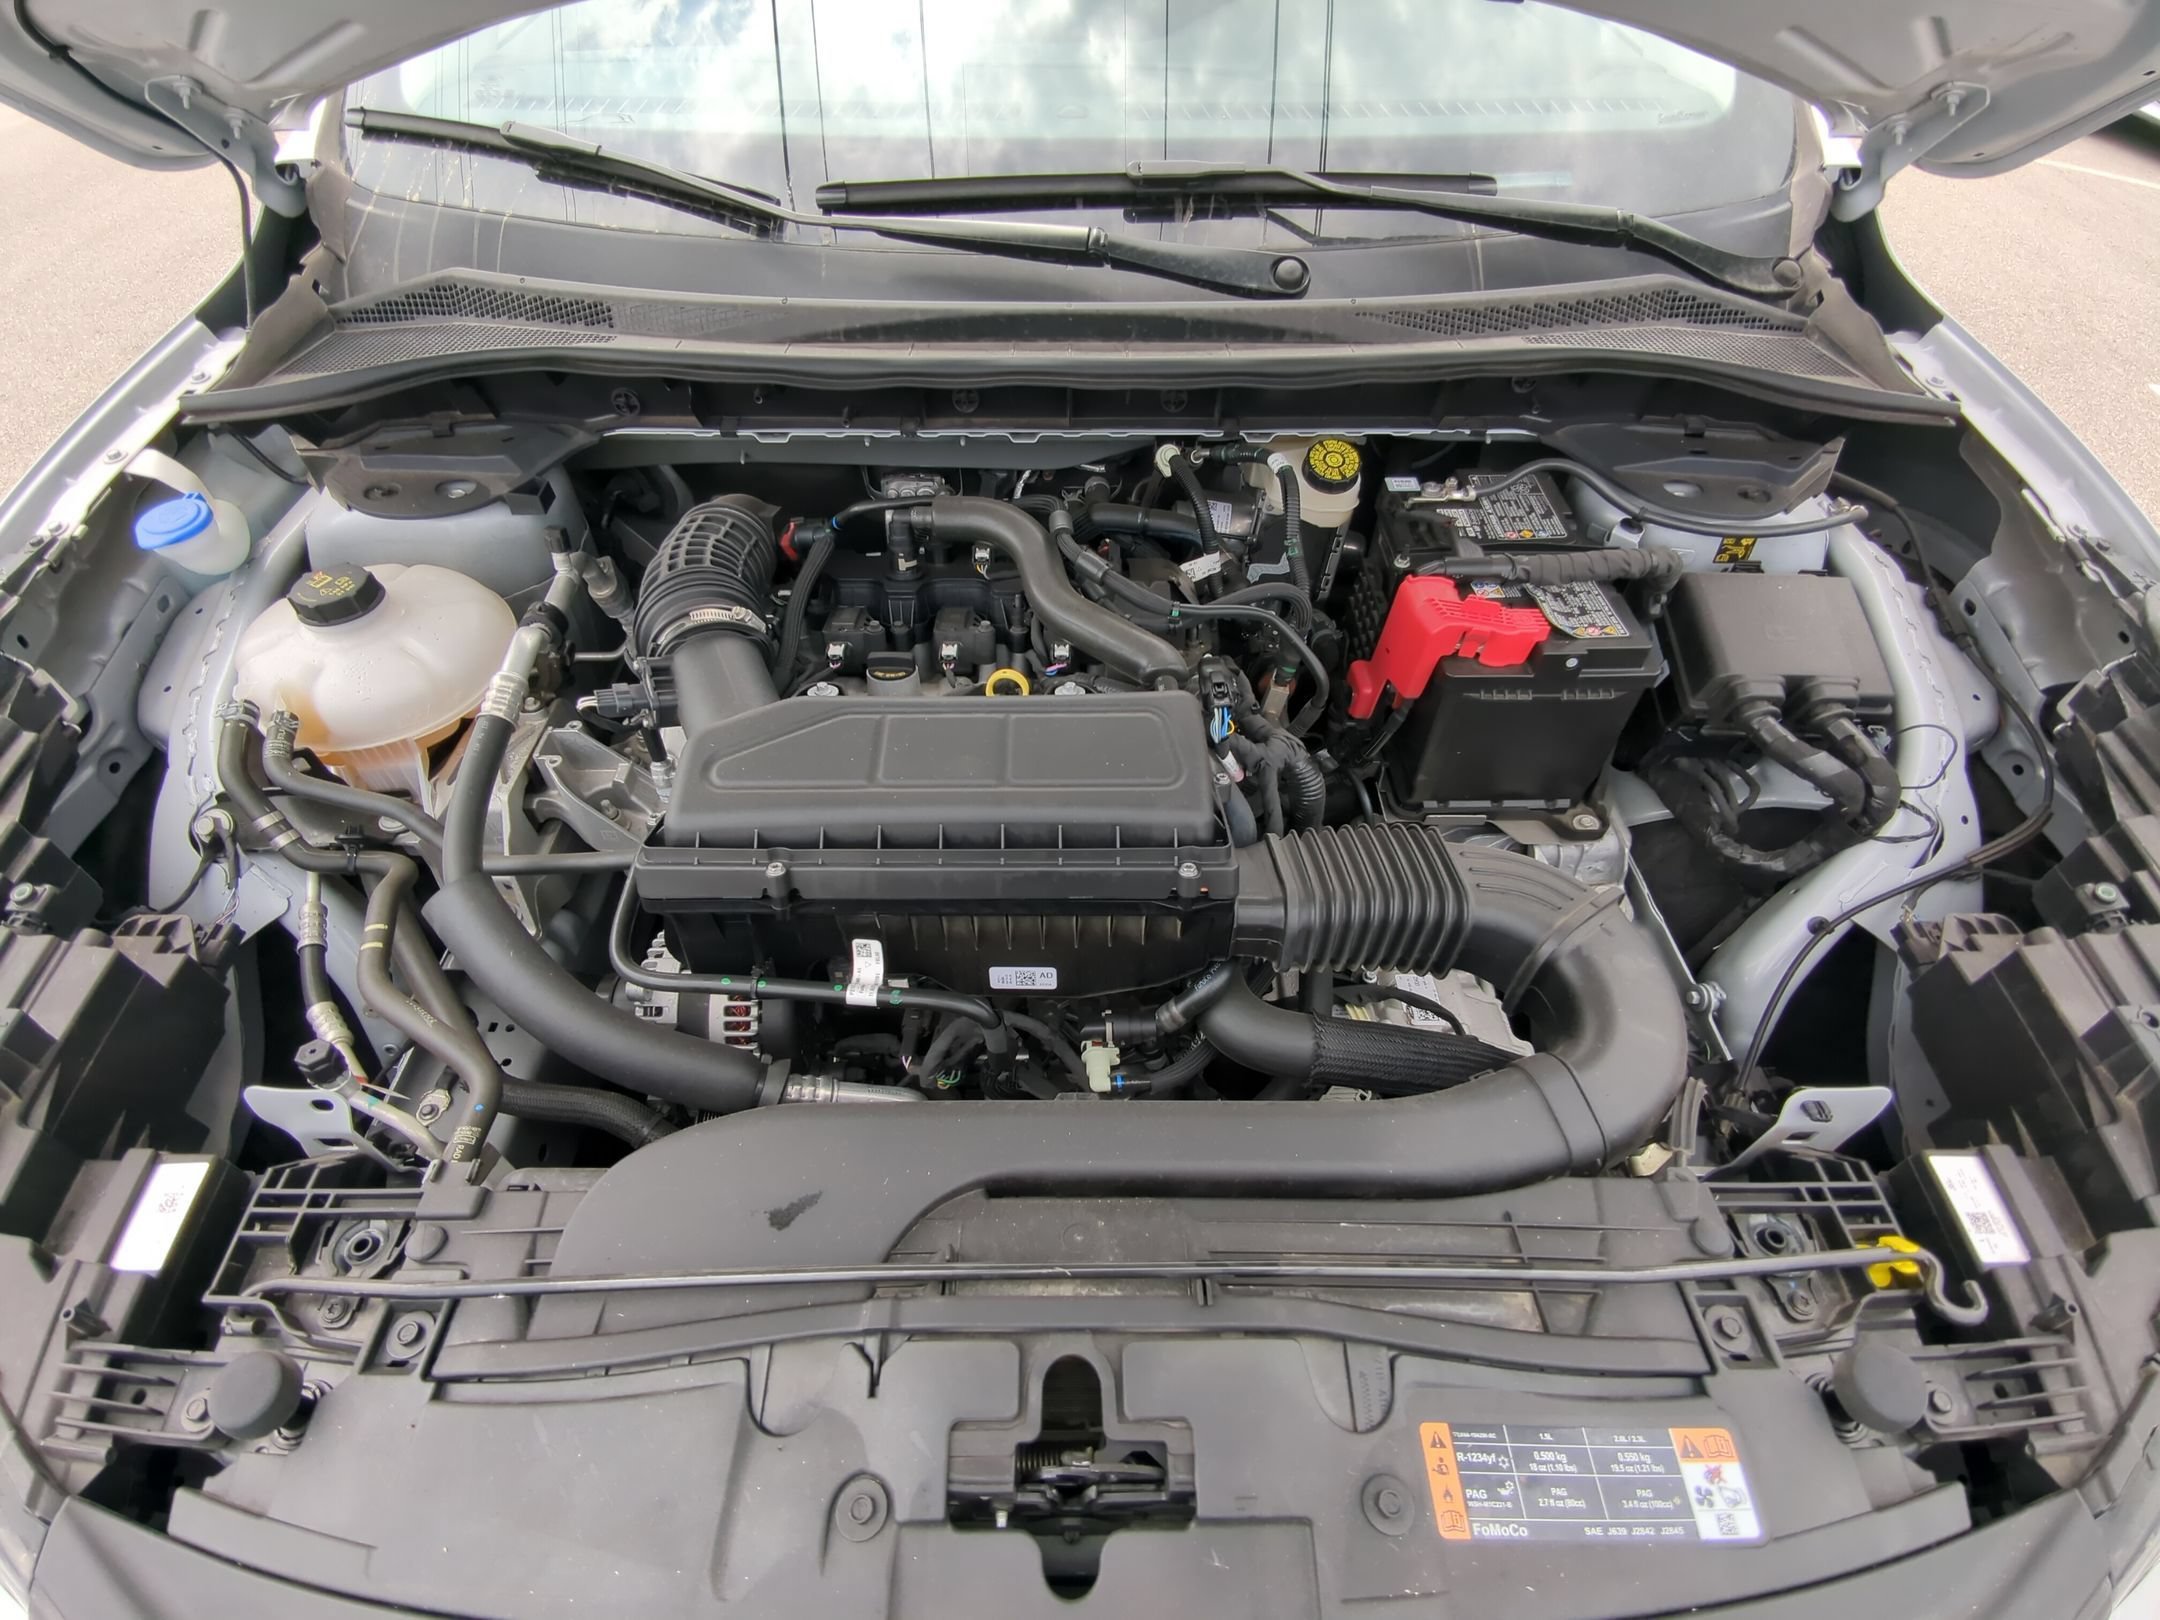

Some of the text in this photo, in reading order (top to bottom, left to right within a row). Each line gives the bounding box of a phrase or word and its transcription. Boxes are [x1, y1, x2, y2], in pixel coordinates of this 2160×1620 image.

[1456, 1452, 1497, 1465] R-1234yf
[1555, 1451, 1568, 1463] kg
[1639, 1452, 1652, 1464] kg
[1465, 1489, 1488, 1499] PAG
[1550, 1487, 1568, 1496] PAG
[1635, 1489, 1653, 1498] PAG
[1472, 1523, 1528, 1537] FoMoCo
[1584, 1527, 1604, 1535] SAE
